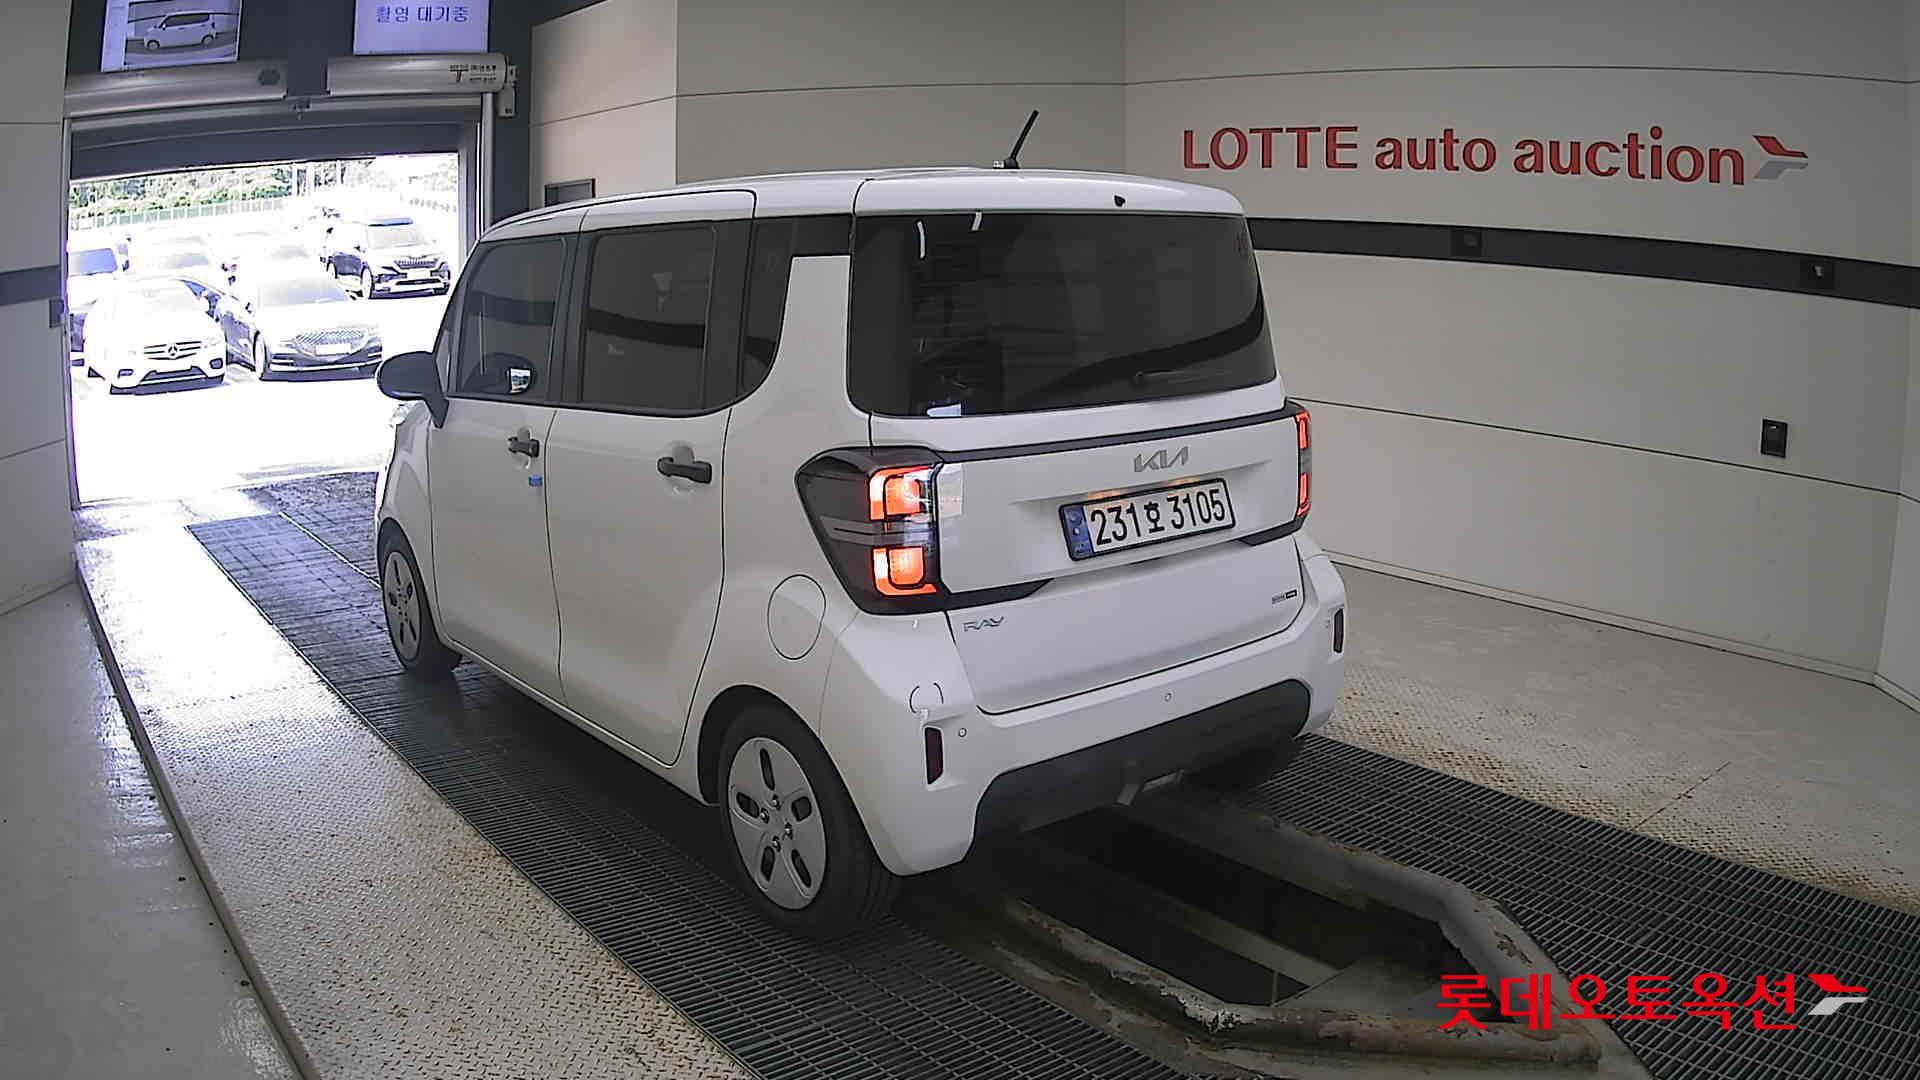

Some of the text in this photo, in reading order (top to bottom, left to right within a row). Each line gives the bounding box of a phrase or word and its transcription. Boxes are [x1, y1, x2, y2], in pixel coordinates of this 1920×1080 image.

[417, 5, 469, 23] 대기중
[1183, 126, 1745, 185] LOTTE auto auction
[1133, 446, 1189, 473] KIA
[1166, 488, 1226, 530] 3105
[963, 616, 1005, 632] RAY
